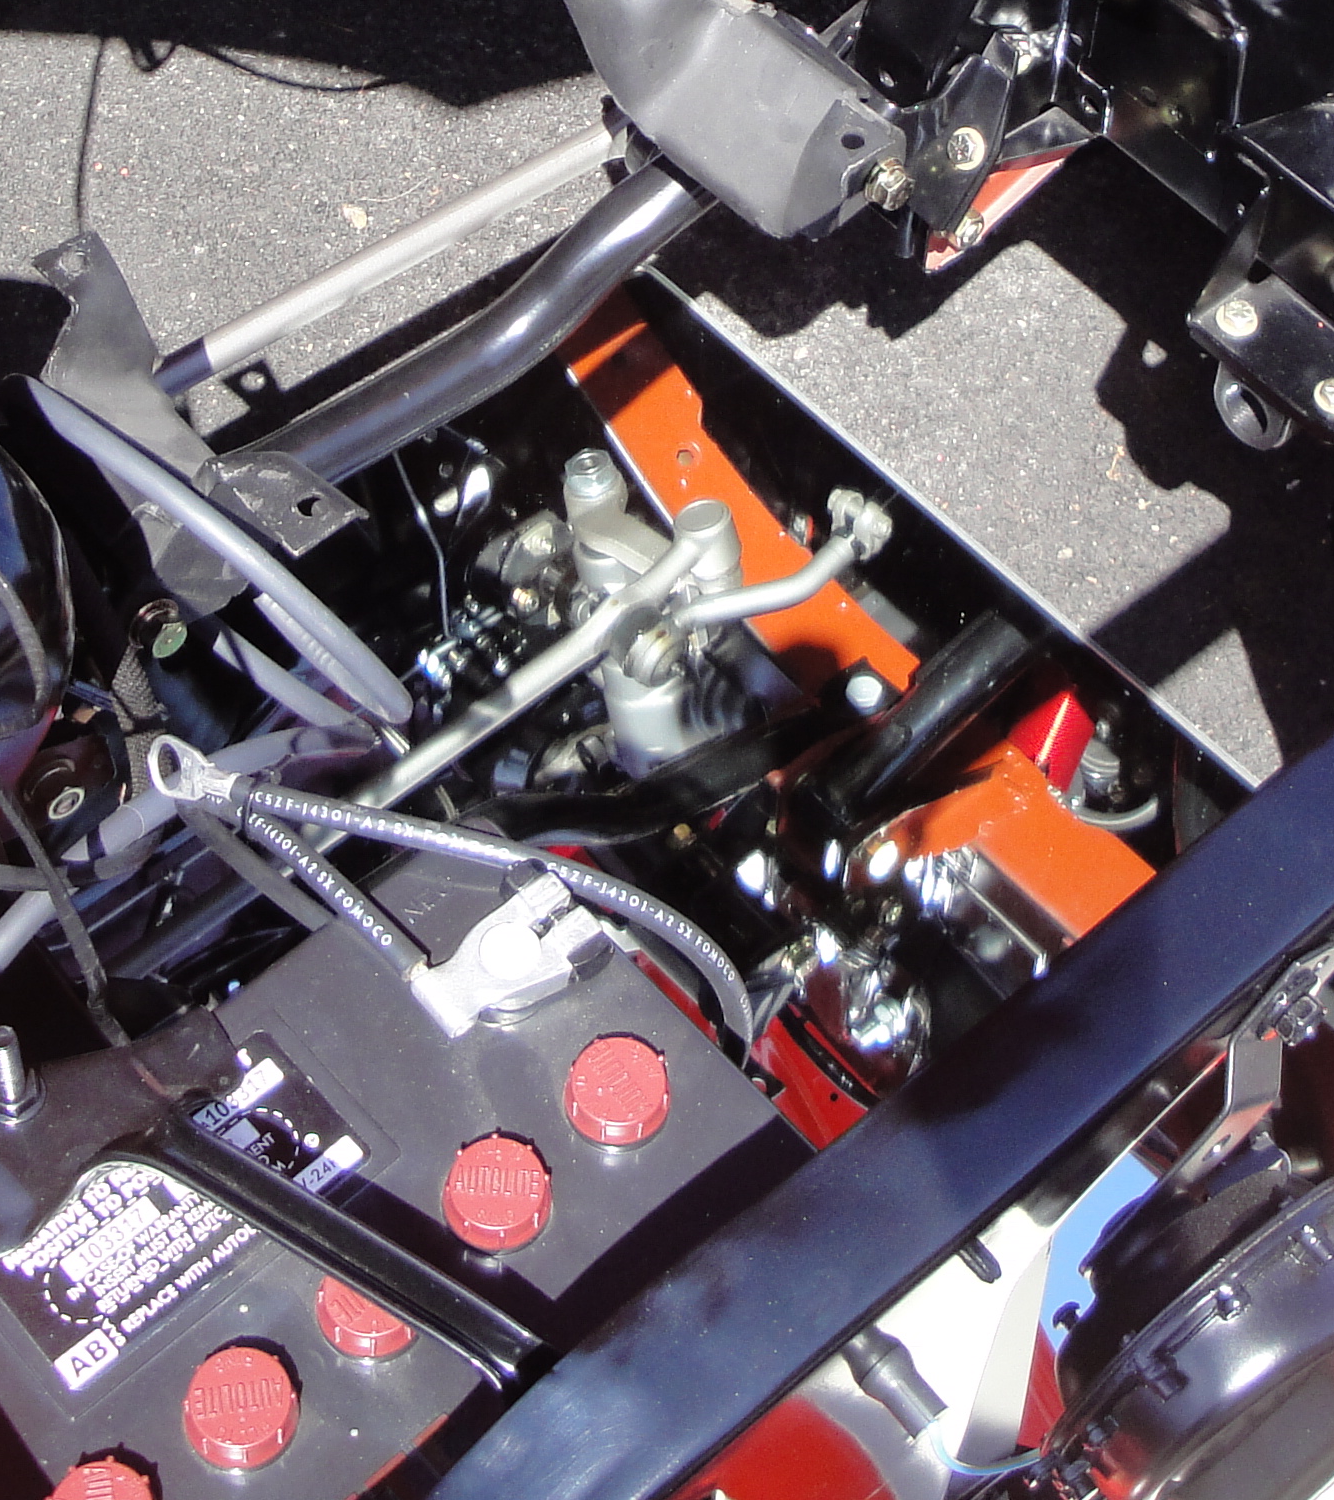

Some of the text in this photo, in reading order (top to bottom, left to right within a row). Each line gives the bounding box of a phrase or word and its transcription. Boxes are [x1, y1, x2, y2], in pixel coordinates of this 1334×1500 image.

[314, 869, 336, 891] SX
[329, 884, 398, 949] FOMOCO
[675, 918, 695, 941] SX
[694, 934, 736, 983] FOMOCO
[81, 1179, 114, 1209] TO
[454, 1165, 539, 1197] AUTOLITE
[19, 1210, 100, 1278] POSITIVE
[93, 1190, 124, 1219] TO
[91, 1258, 137, 1298] INSERT
[133, 1230, 173, 1265] MUST
[167, 1218, 188, 1238] BE
[94, 1256, 162, 1313] RETURNED
[156, 1231, 194, 1265] WITH
[64, 1280, 87, 1302] IN
[119, 1282, 180, 1334] REPLACE
[175, 1255, 214, 1290] WITH
